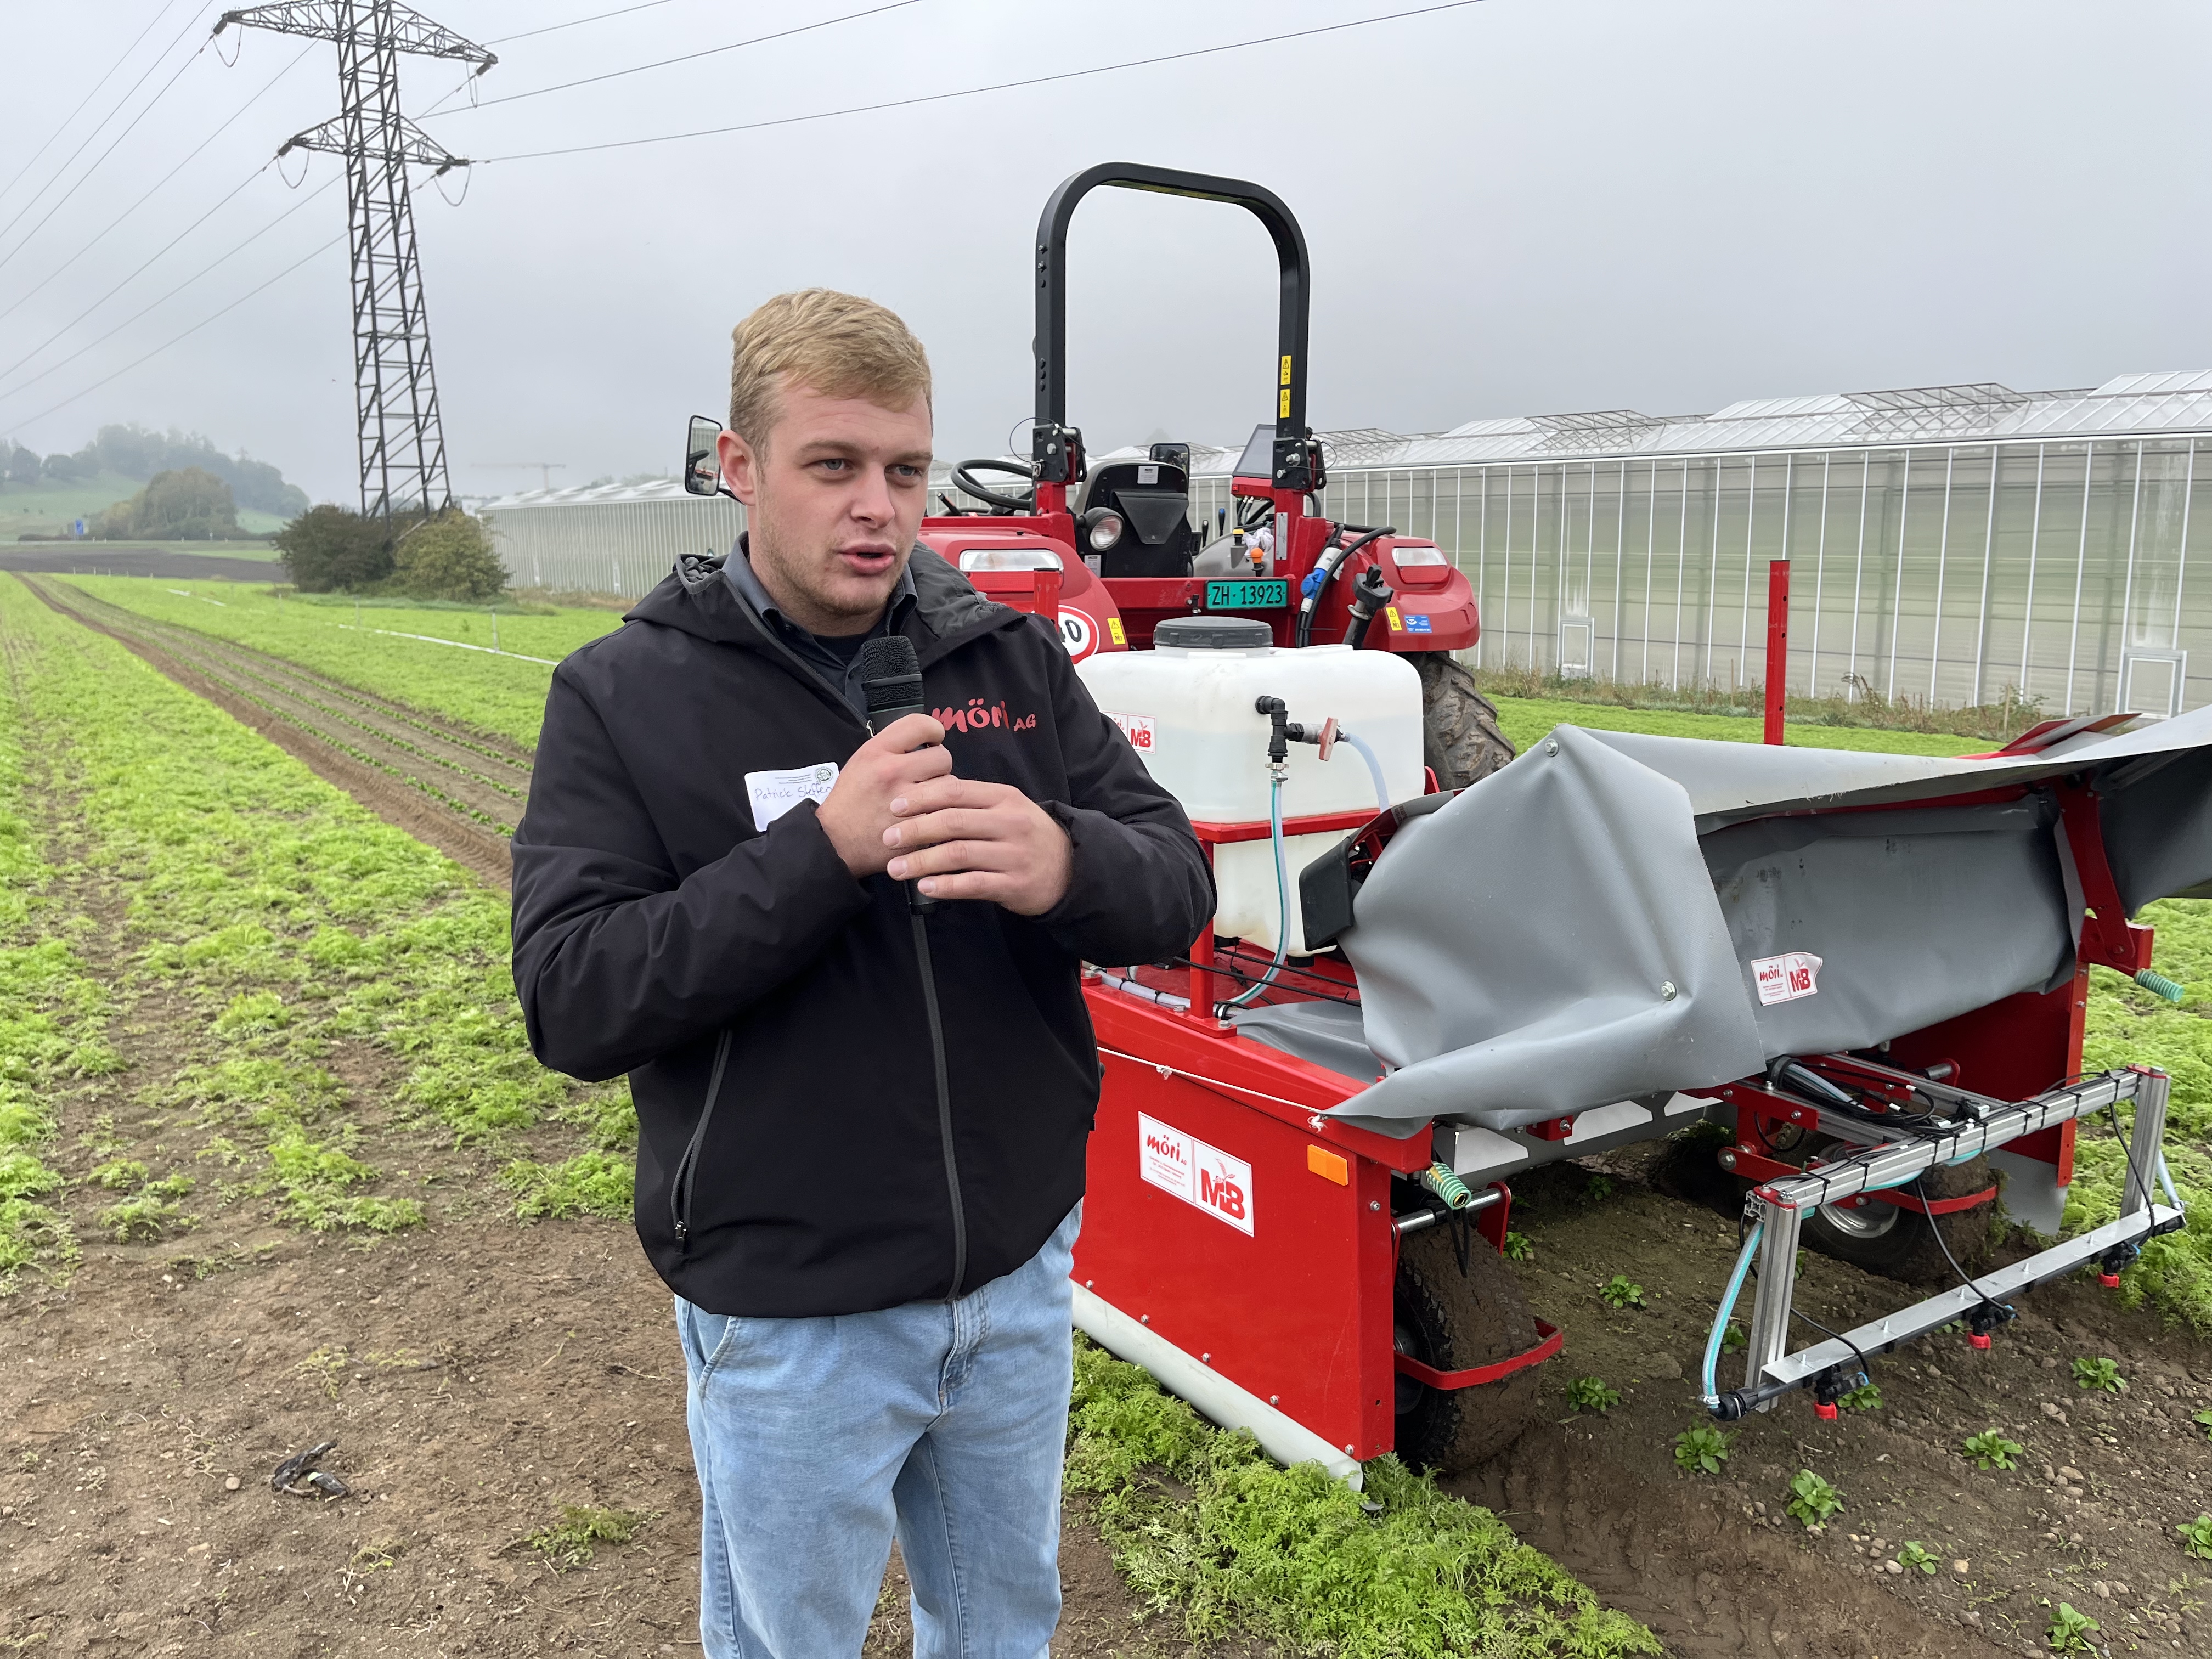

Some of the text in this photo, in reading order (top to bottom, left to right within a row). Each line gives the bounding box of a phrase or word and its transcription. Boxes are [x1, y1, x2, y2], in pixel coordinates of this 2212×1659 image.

[1212, 585, 1282, 605] ZH 13923
[932, 698, 1036, 733] möri AG
[754, 787, 793, 801] Patrick
[1759, 964, 1780, 982] möri
[1147, 1134, 1180, 1162] möri
